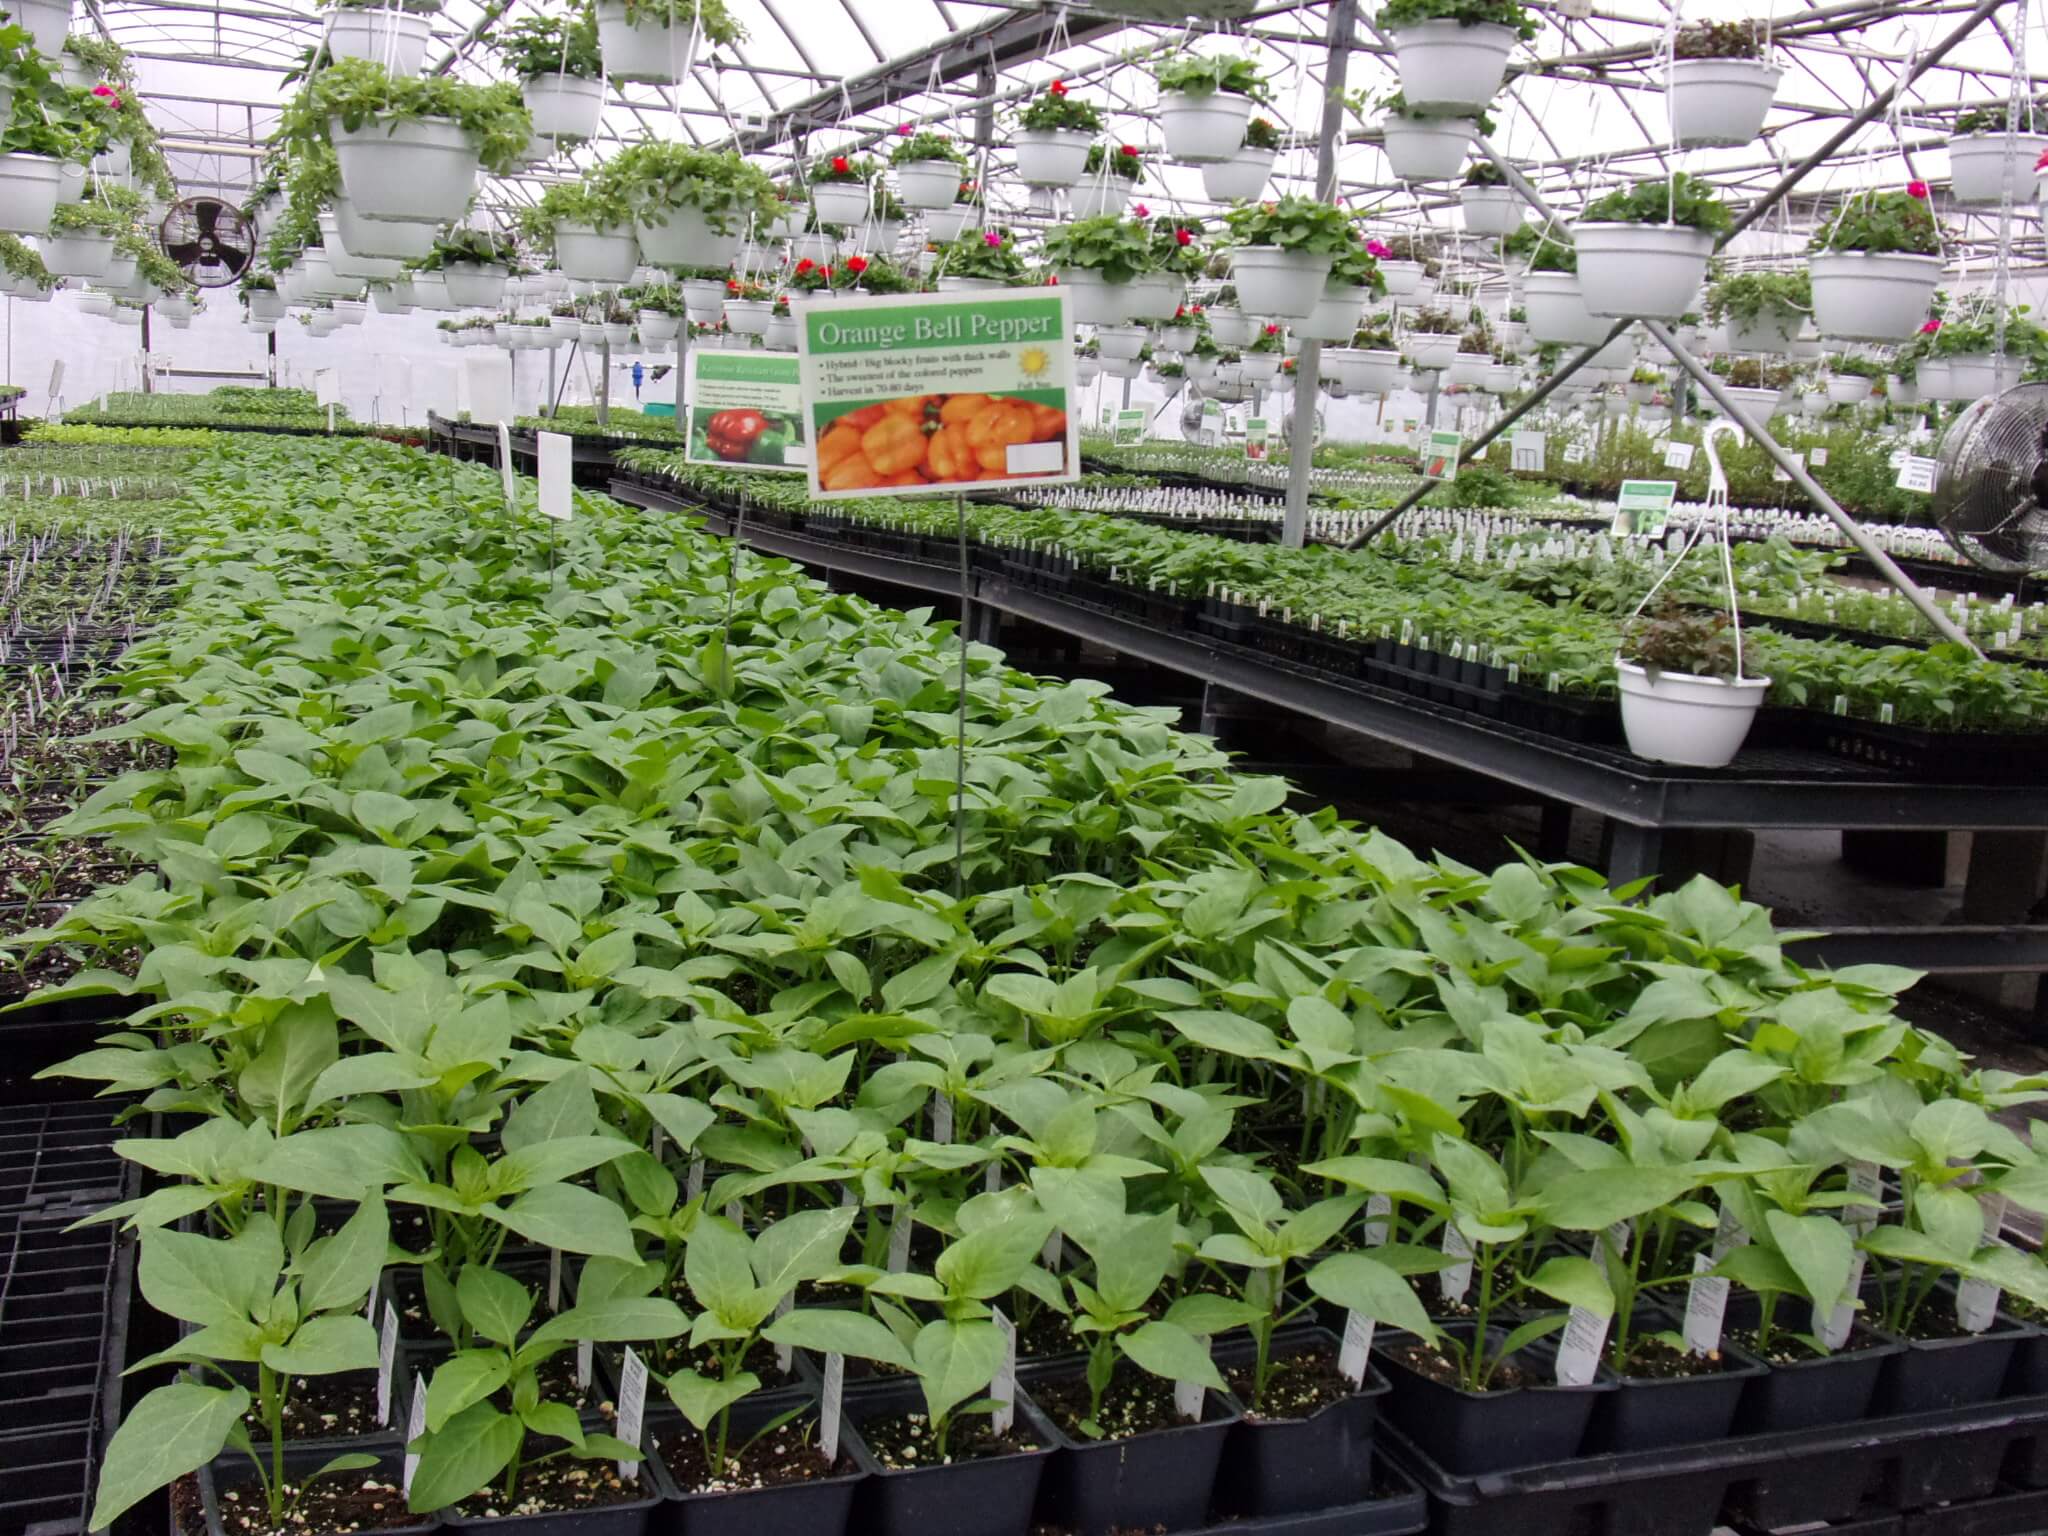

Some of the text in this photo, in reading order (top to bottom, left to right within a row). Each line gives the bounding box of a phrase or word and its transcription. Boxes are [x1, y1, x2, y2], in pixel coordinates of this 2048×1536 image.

[820, 313, 1053, 349] Orange Bell Pepper
[826, 357, 857, 370] Hybrid
[883, 355, 912, 367] blocky
[942, 353, 961, 362] with
[964, 351, 984, 361] thick
[988, 349, 1011, 359] walls
[826, 367, 983, 383] The sweetest of the colored peppers
[828, 386, 862, 396] Harvest
[903, 382, 924, 394] days
